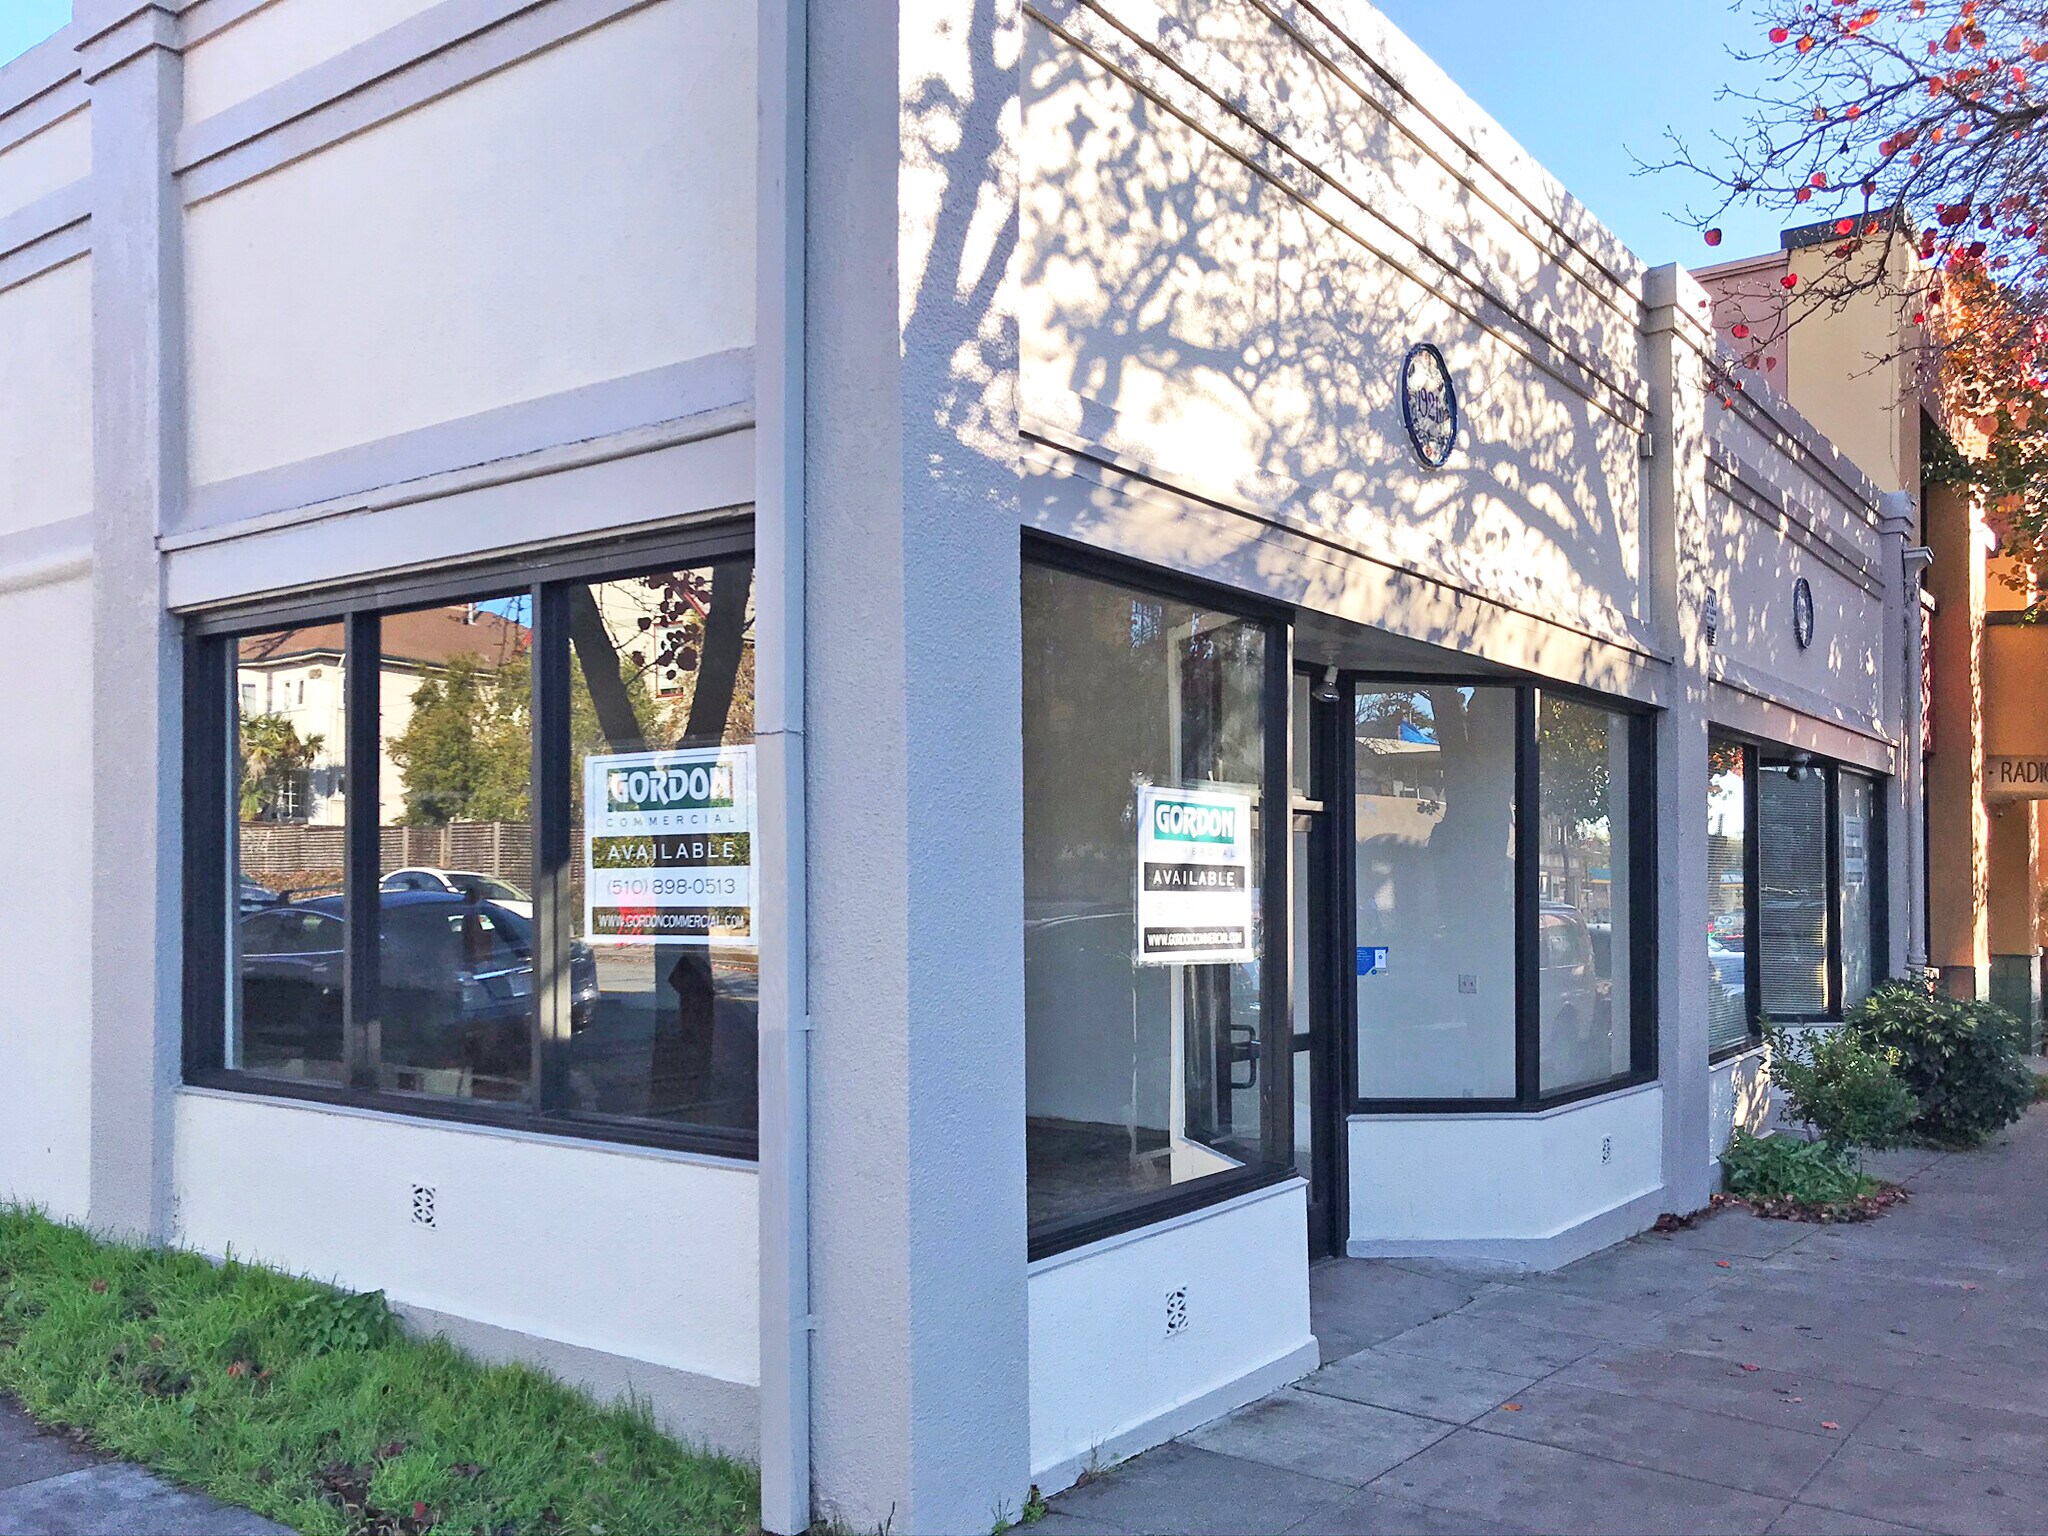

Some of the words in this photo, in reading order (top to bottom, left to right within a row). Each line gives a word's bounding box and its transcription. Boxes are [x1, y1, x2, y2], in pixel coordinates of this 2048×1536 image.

[2001, 761, 2048, 782] RADI
[611, 767, 731, 805] GORDON
[606, 814, 735, 828] COMMERCIAL
[1155, 803, 1235, 838] GORDON
[607, 841, 735, 860] AVAILABLE
[608, 879, 648, 896] (510)
[652, 878, 736, 895] 898-0513
[1153, 869, 1235, 887] AVAILABLE
[599, 914, 745, 929] WWW.GORDONCOMMERCIAL.COM
